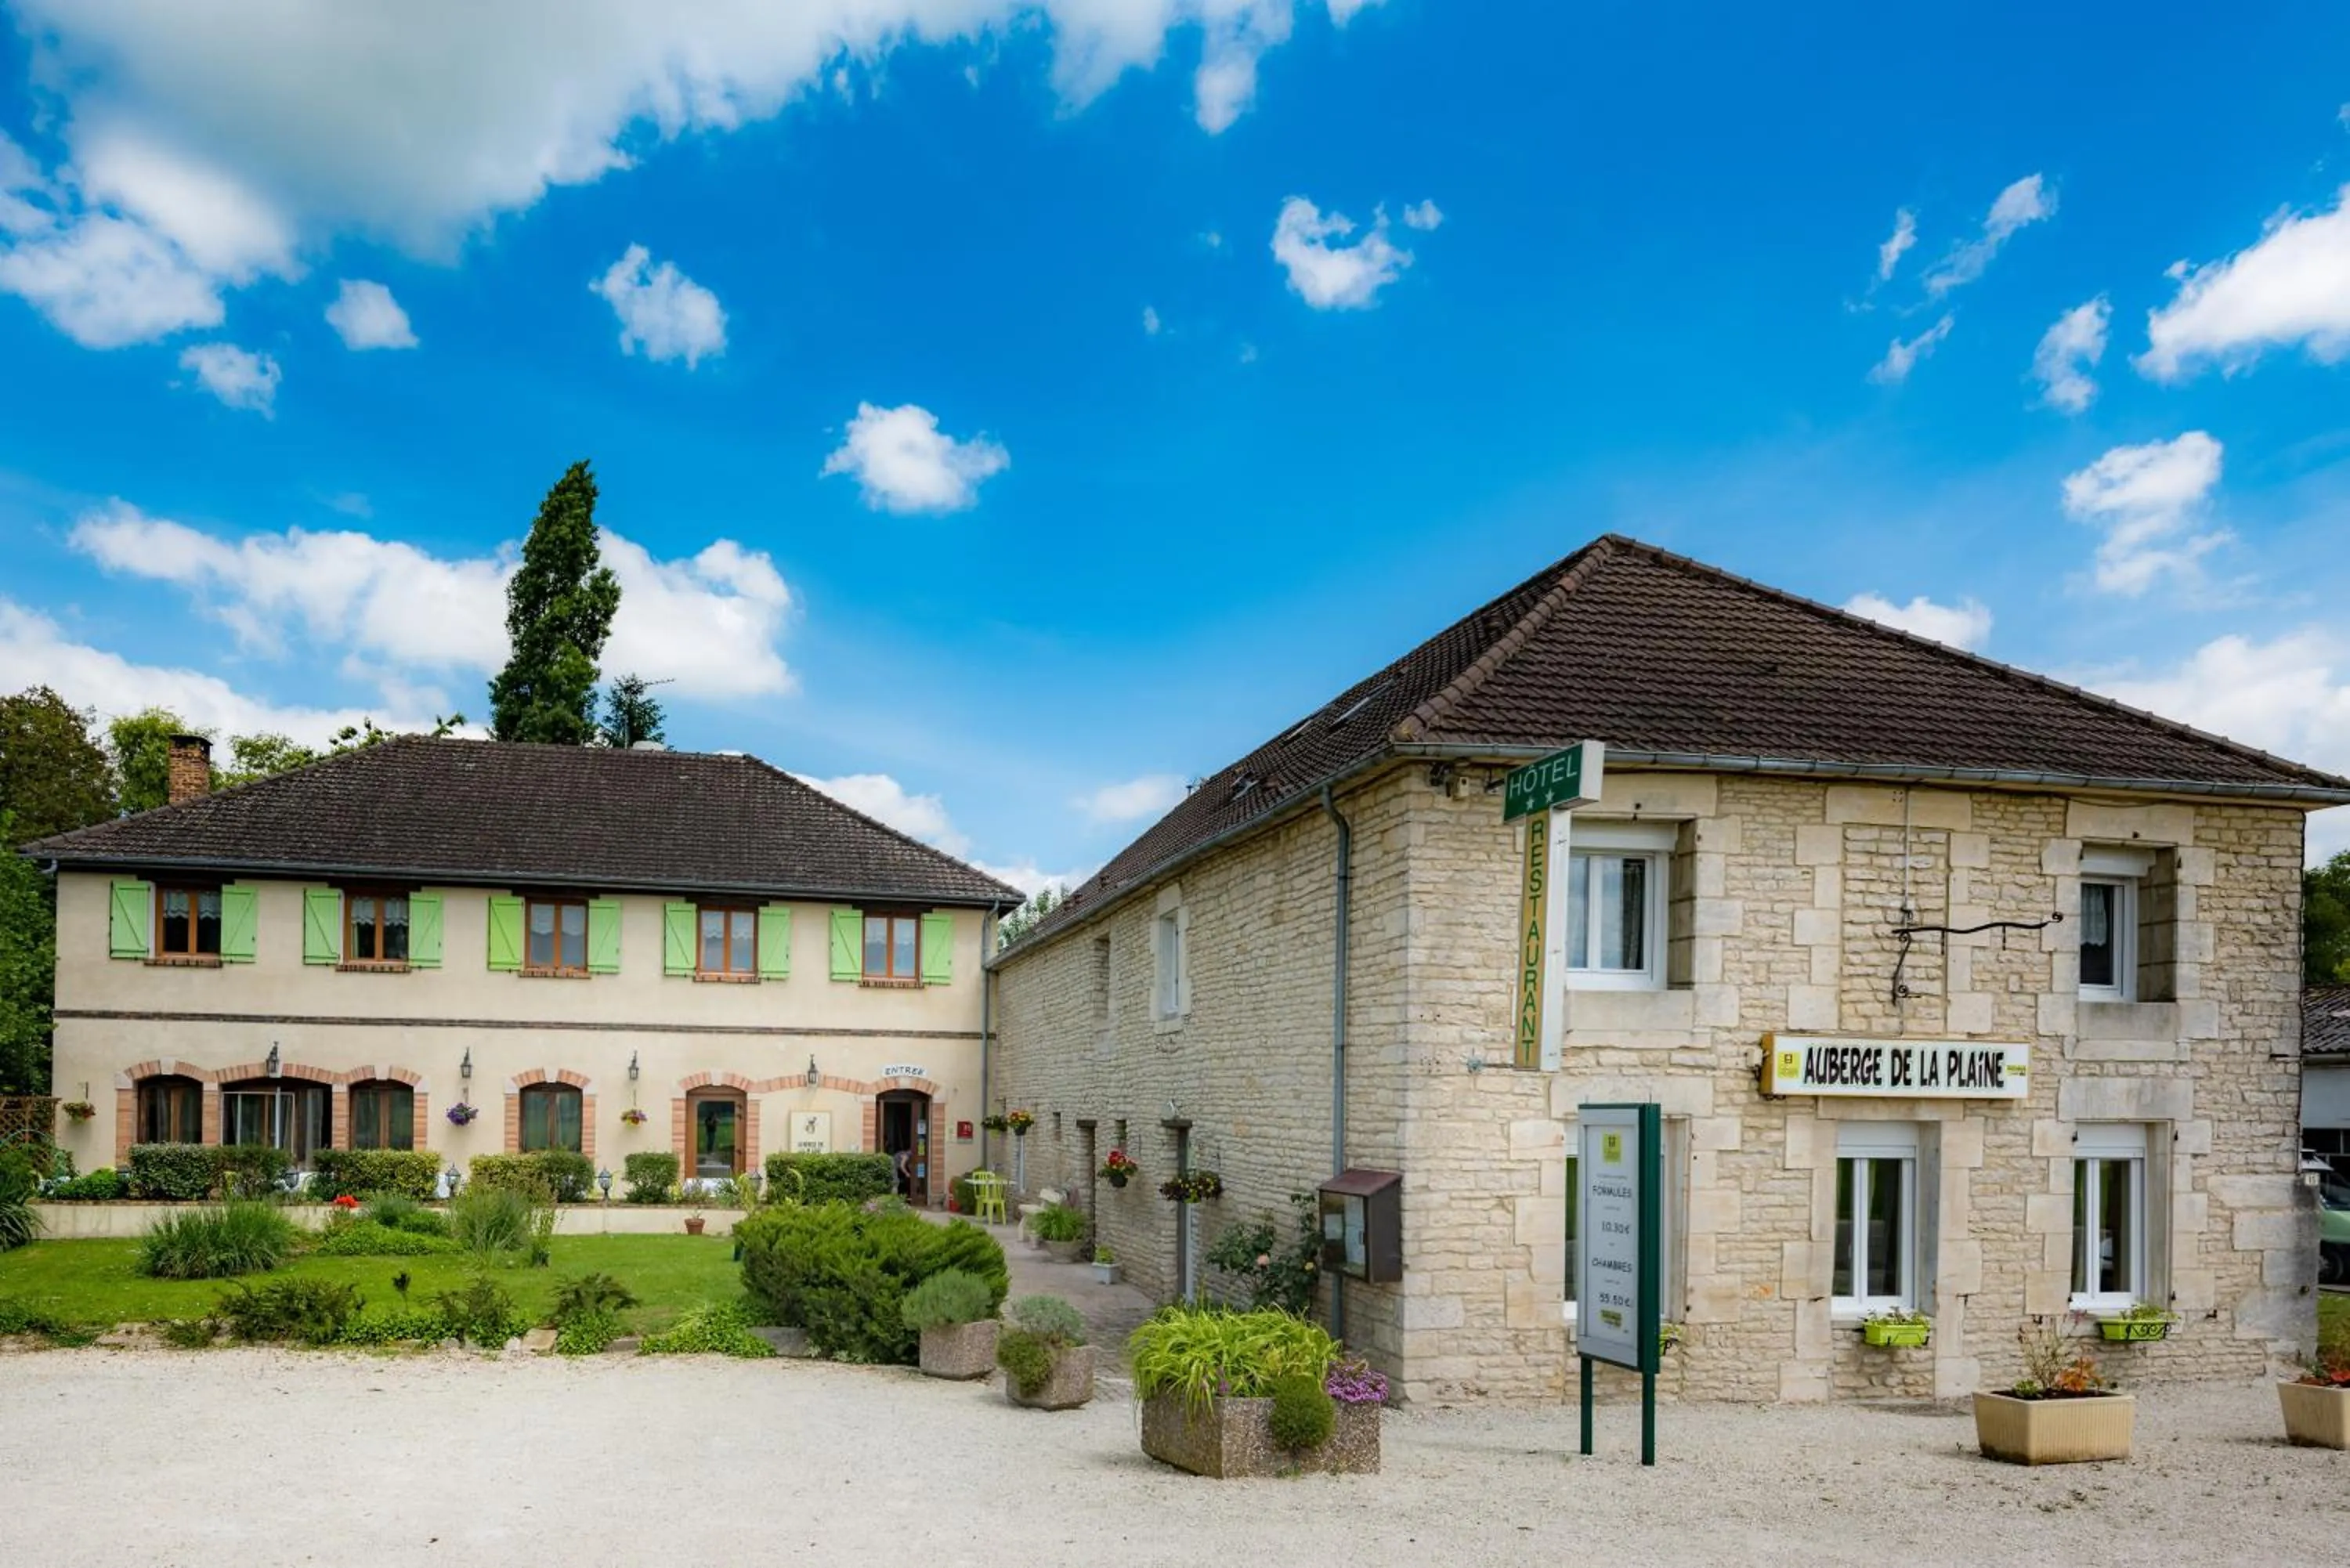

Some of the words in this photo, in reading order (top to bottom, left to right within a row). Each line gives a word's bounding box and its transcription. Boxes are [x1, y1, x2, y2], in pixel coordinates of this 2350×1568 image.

[1509, 754, 1578, 797] HÔTEL
[1521, 819, 1545, 1065] RESTAURANT
[1803, 1046, 1882, 1086] AUBERGE
[1890, 1049, 1913, 1087] DE
[1920, 1050, 1940, 1087] LA
[1591, 1257, 1632, 1273] CHAMBRES
